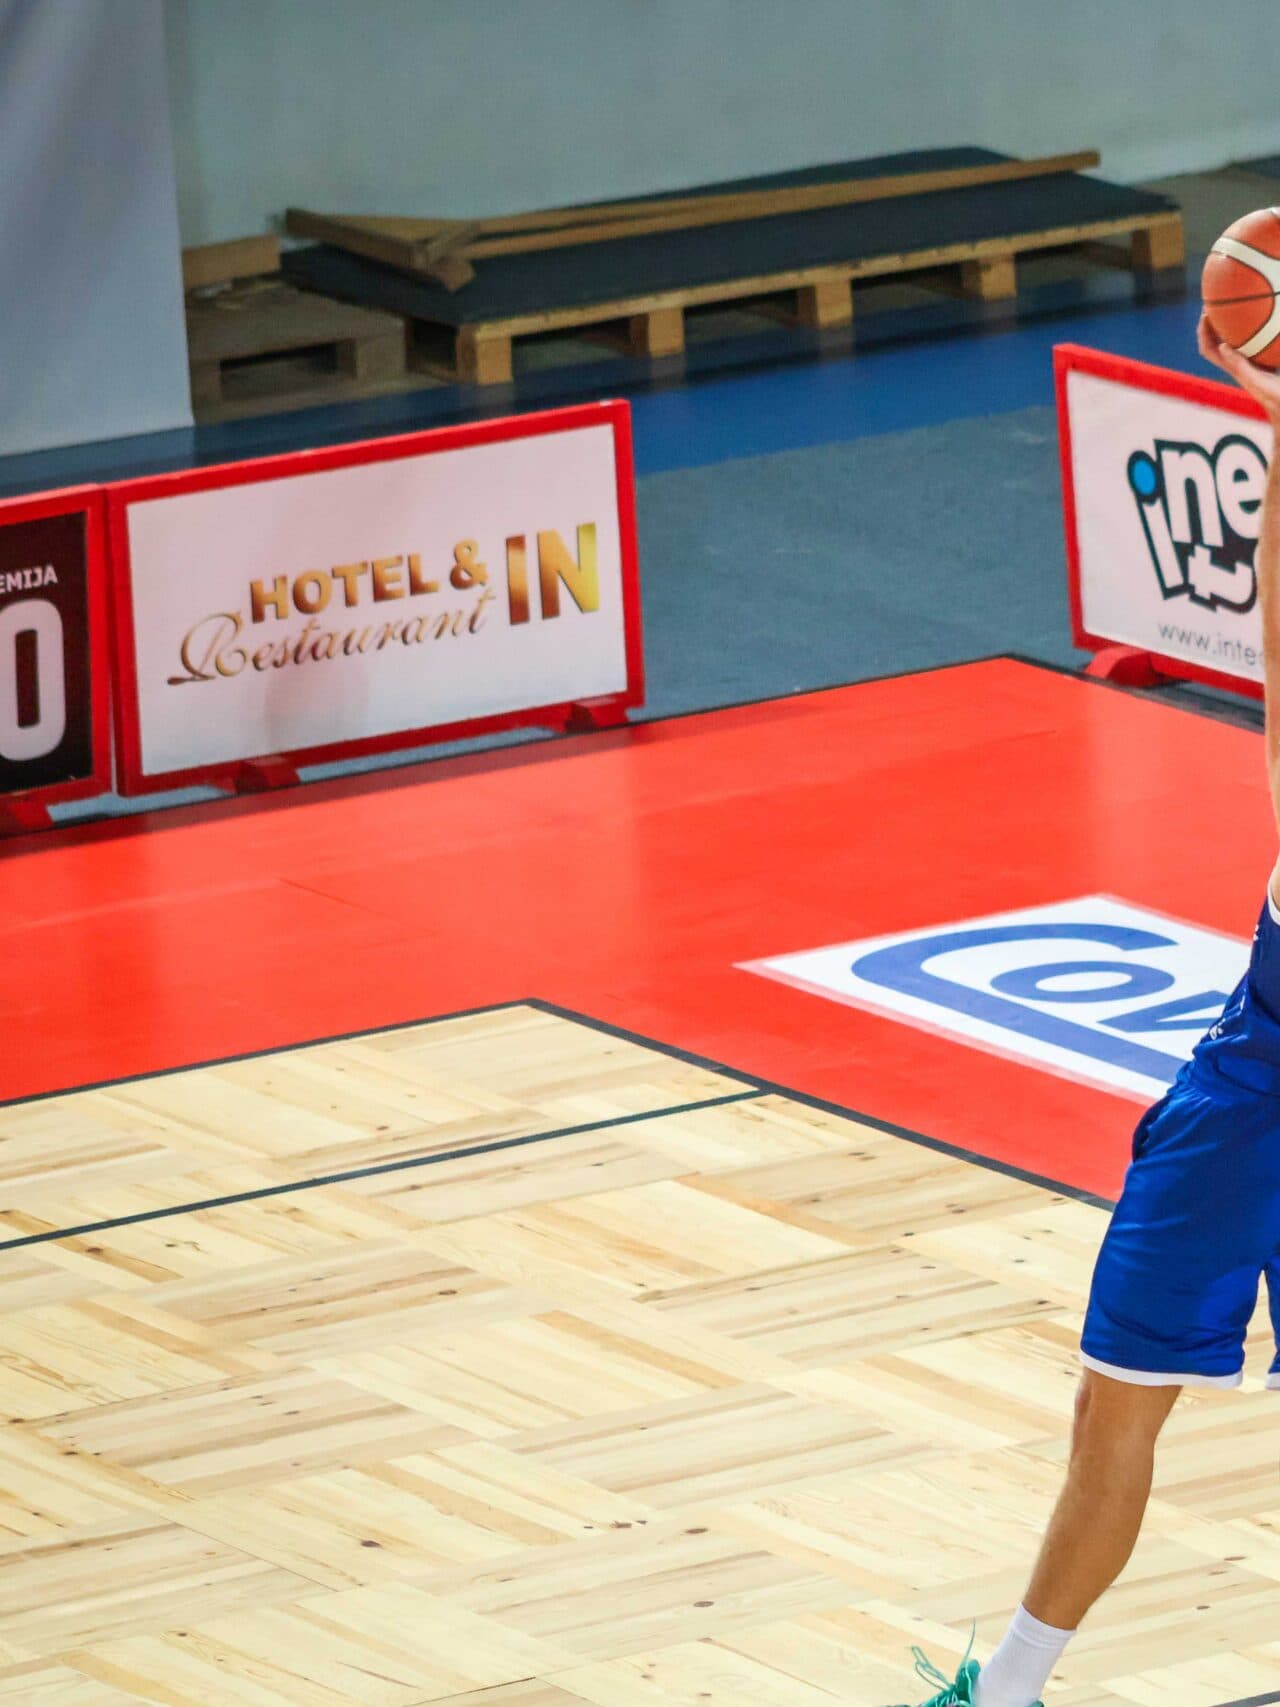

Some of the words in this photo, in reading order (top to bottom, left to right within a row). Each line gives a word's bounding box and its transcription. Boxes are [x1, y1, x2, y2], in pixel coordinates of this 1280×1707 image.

[249, 553, 439, 624] HOTEL
[449, 538, 488, 590] &
[506, 522, 600, 626] IN
[167, 588, 496, 686] Restaurant
[1158, 621, 1264, 667] www.inte
